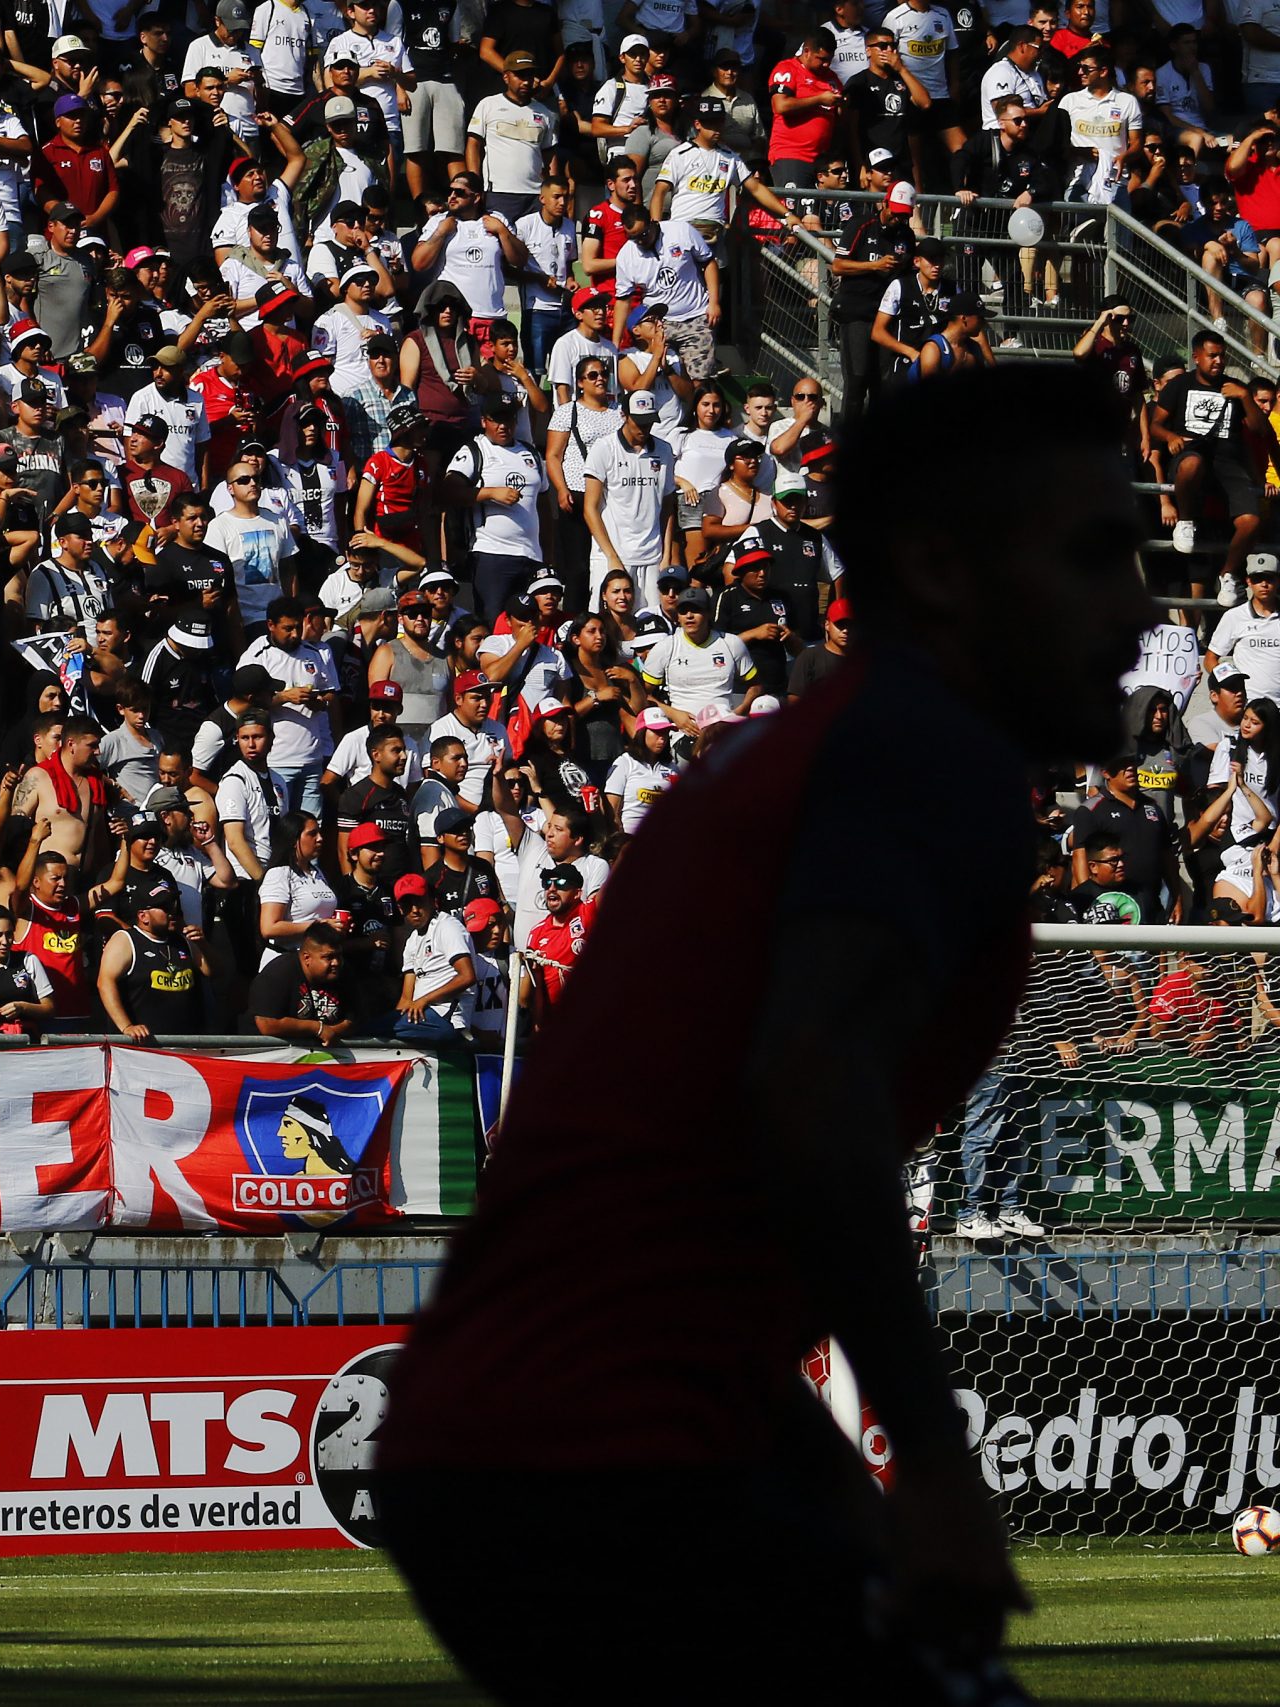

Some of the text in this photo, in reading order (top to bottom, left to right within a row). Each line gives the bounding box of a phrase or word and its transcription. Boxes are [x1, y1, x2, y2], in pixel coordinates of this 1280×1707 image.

[622, 477, 658, 488] DIRECTV
[30, 1389, 301, 1479] MTS
[140, 1494, 180, 1529] de
[188, 1490, 301, 1528] verdad
